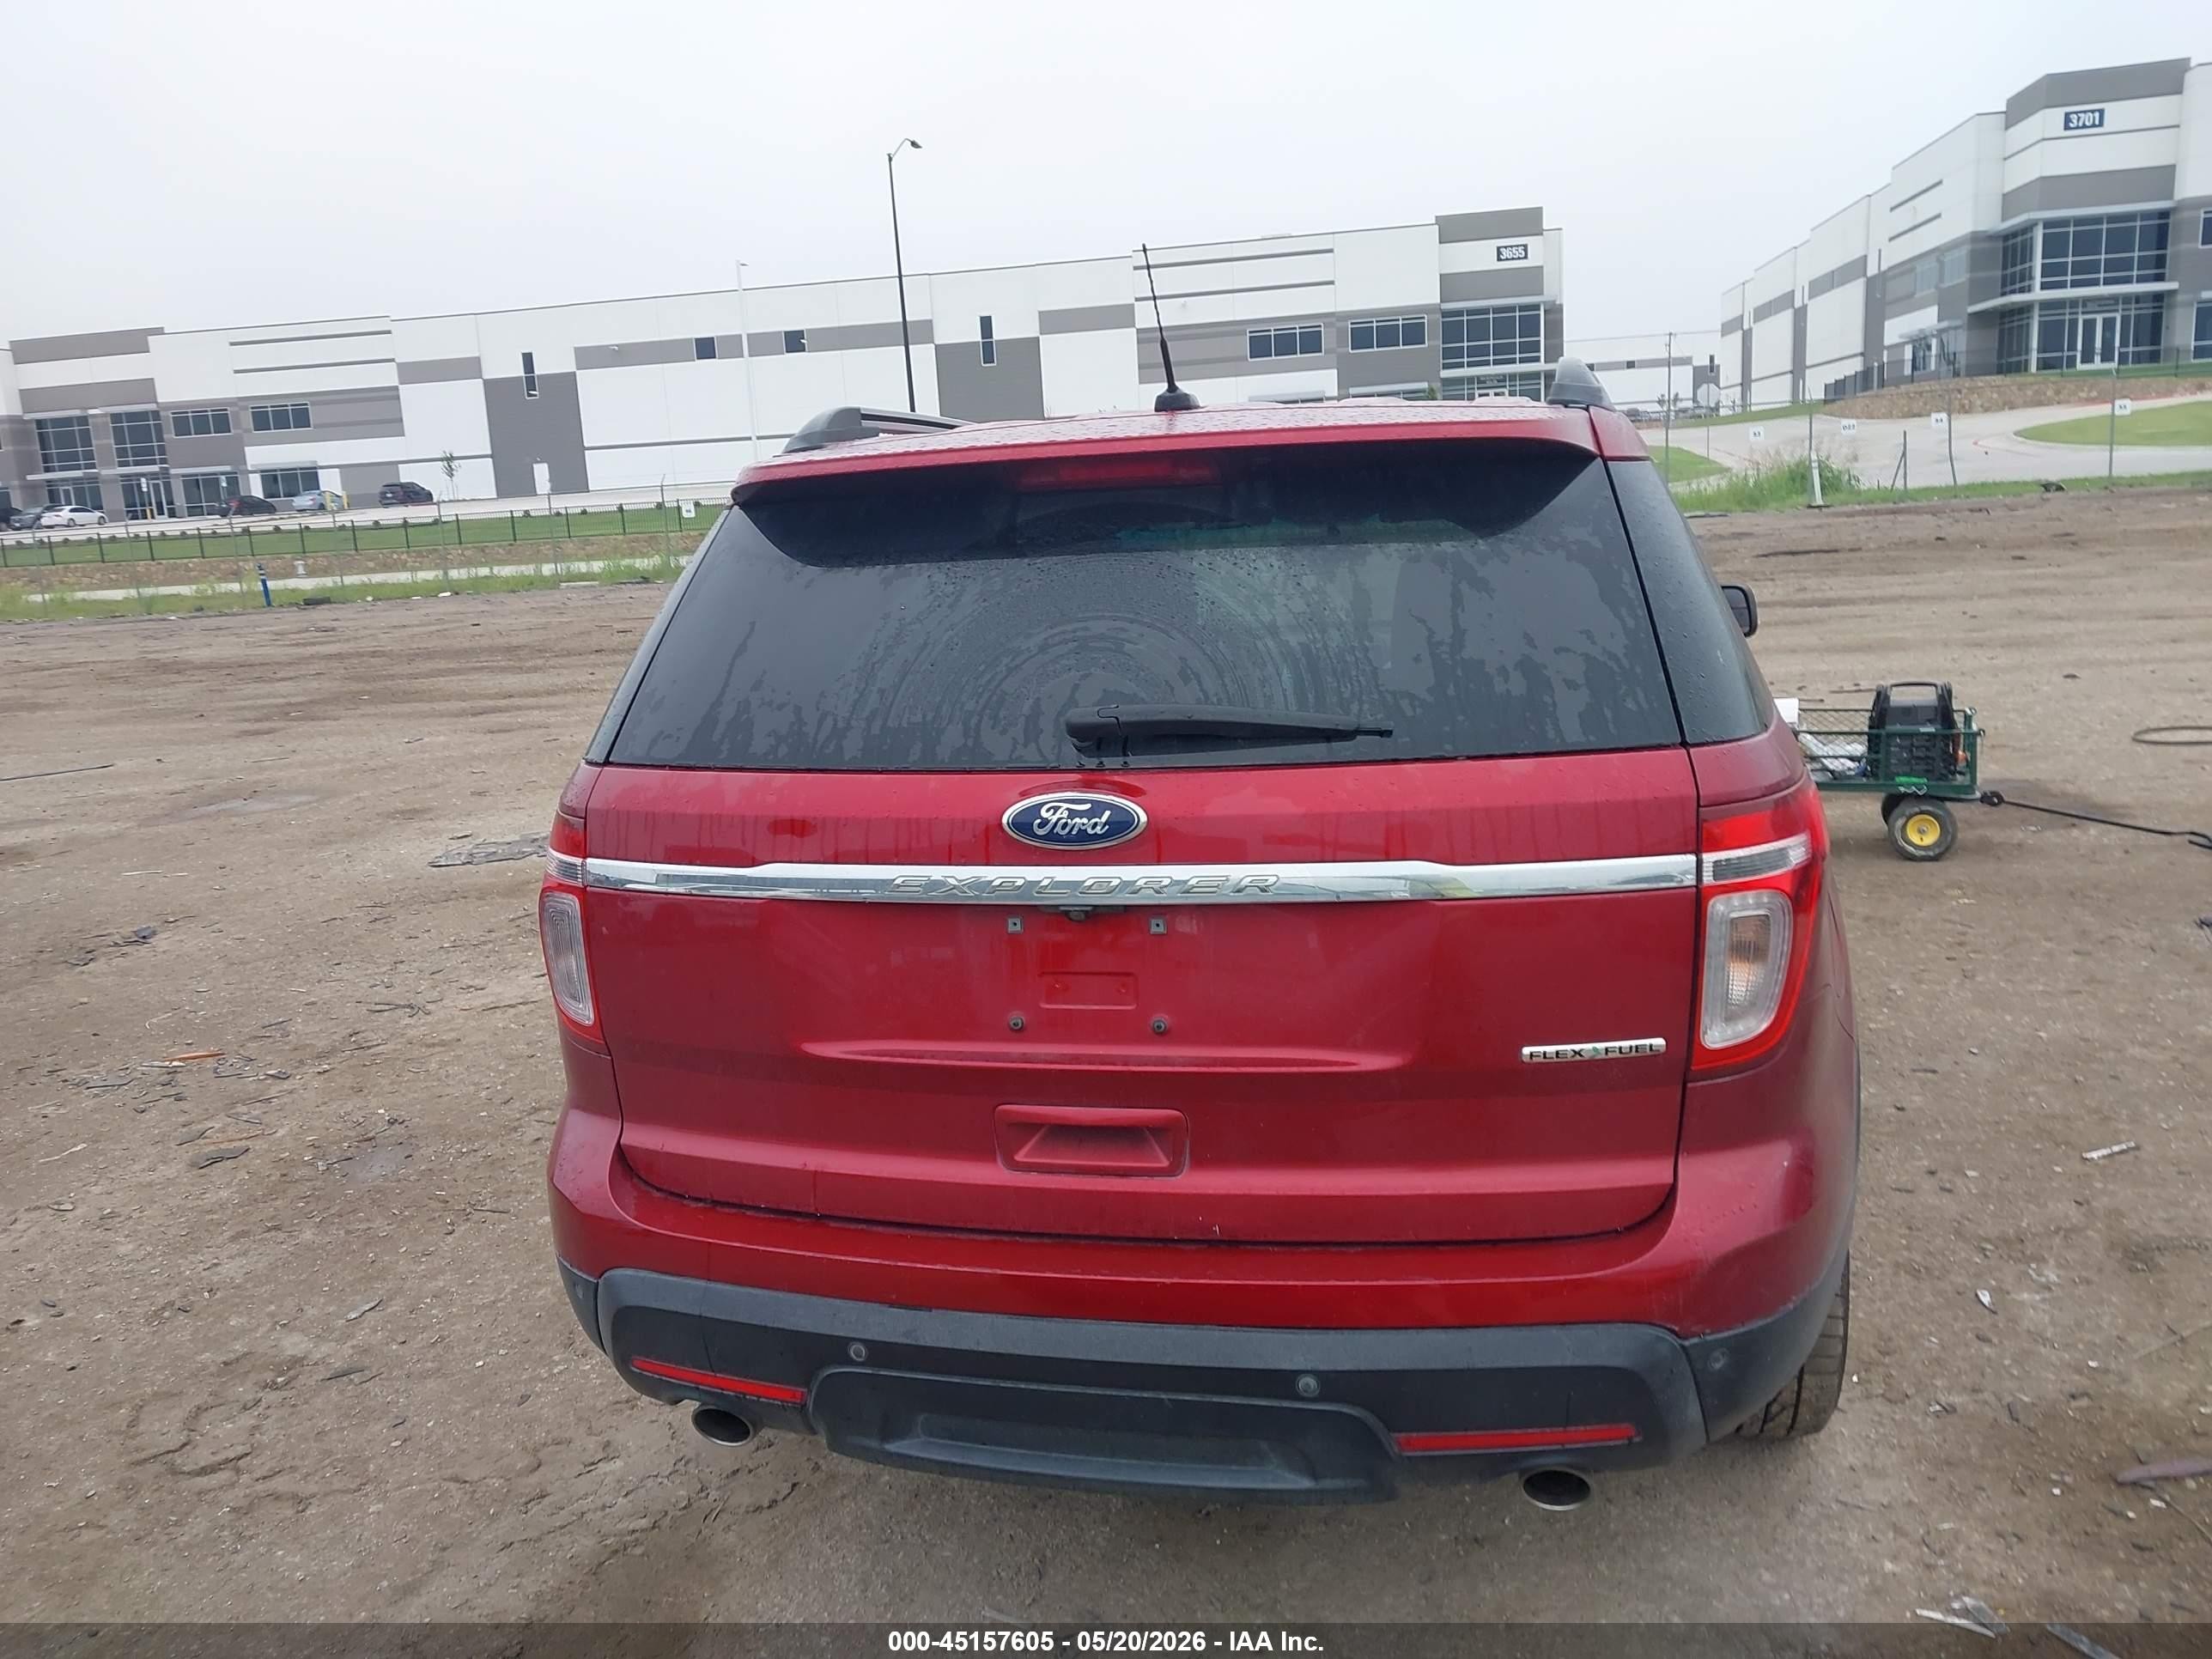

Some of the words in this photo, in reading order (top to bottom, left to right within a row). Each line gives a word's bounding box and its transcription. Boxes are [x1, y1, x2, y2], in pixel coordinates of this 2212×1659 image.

[2069, 111, 2100, 128] 3701
[1499, 246, 1525, 259] 3655
[1032, 802, 1112, 836] Ford
[884, 874, 1282, 897] EXPLORER
[1528, 1048, 1585, 1060] FLEX
[1604, 1042, 1661, 1056] FUEL
